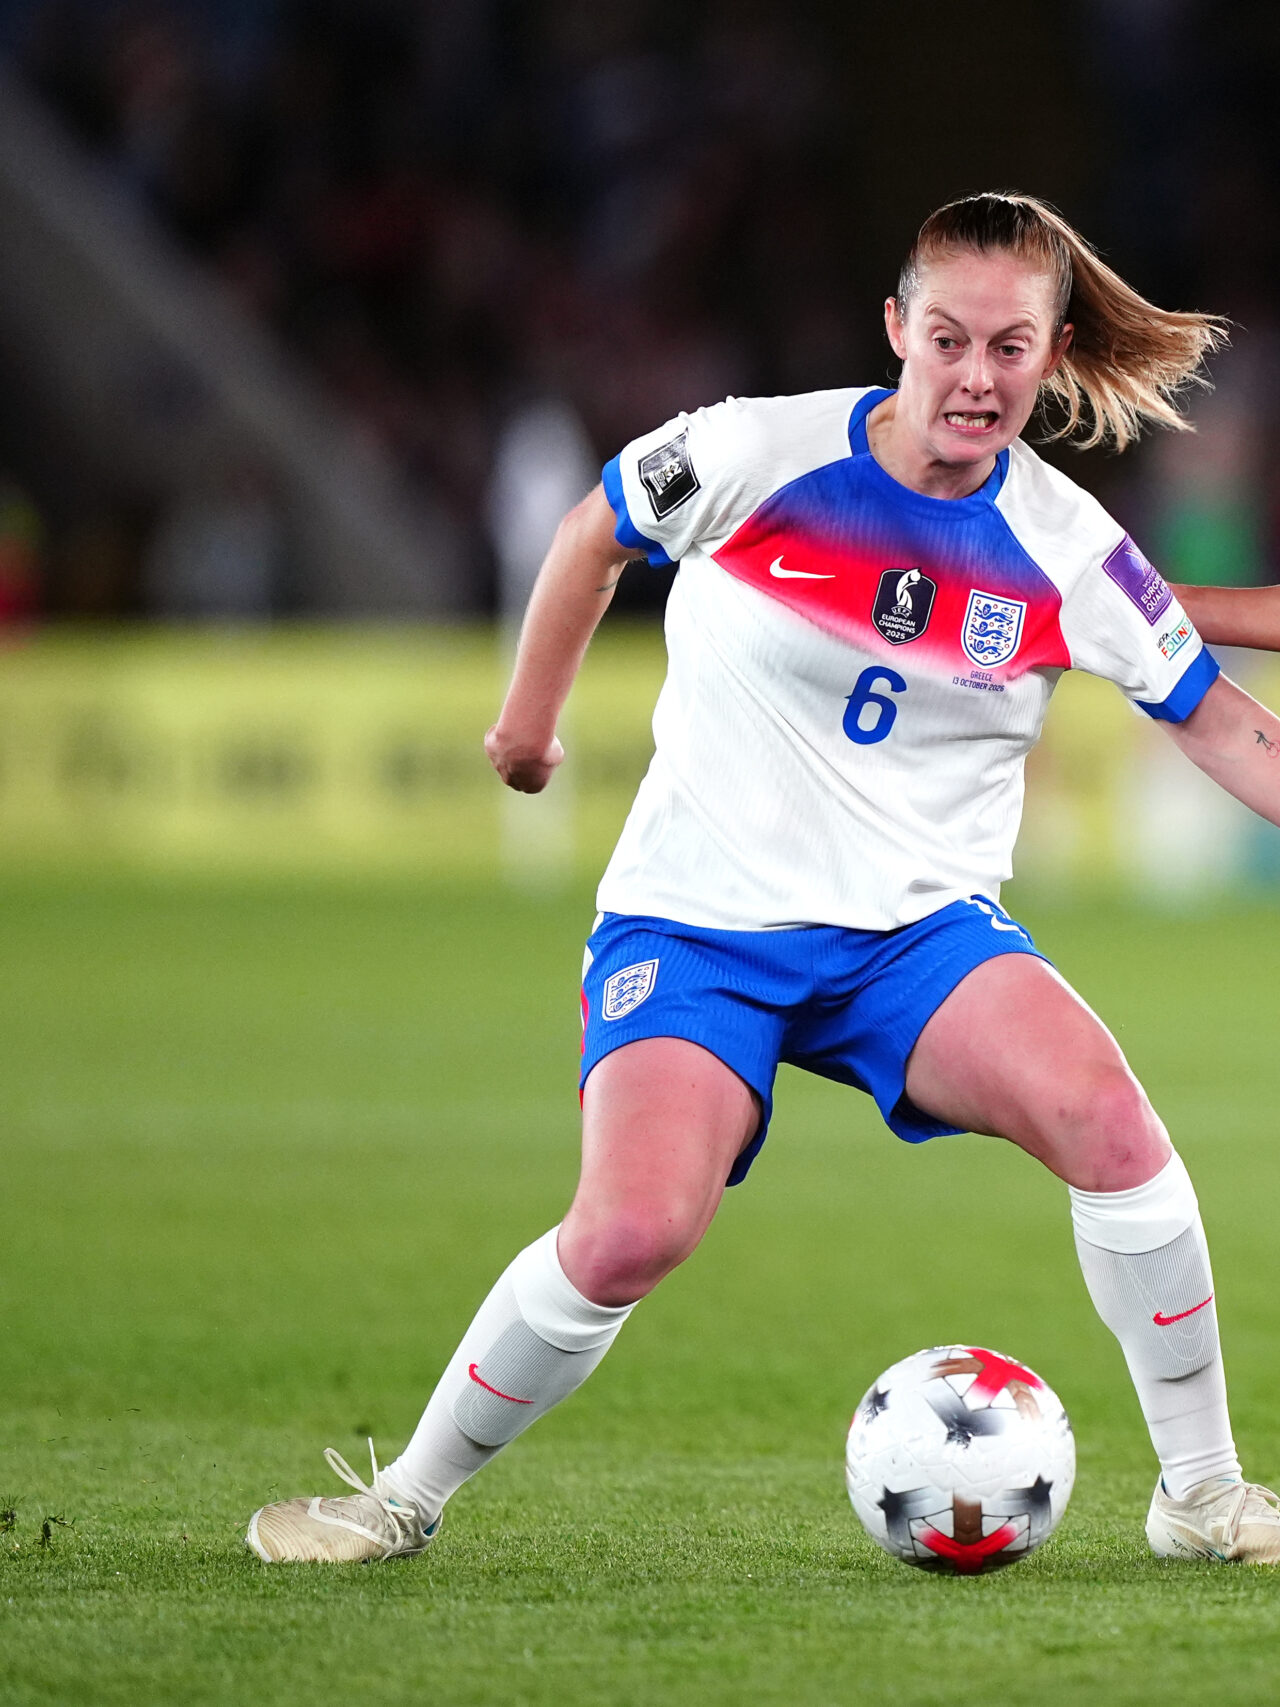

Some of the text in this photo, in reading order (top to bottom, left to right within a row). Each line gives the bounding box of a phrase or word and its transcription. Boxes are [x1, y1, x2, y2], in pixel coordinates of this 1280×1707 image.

[878, 619, 916, 634] CHAMPIONS
[881, 613, 916, 627] EUROPEAN
[885, 629, 906, 640] 2025
[952, 676, 960, 685] 13
[960, 678, 988, 690] OCTOBER
[970, 670, 993, 682] GREECE
[842, 665, 907, 745] 6
